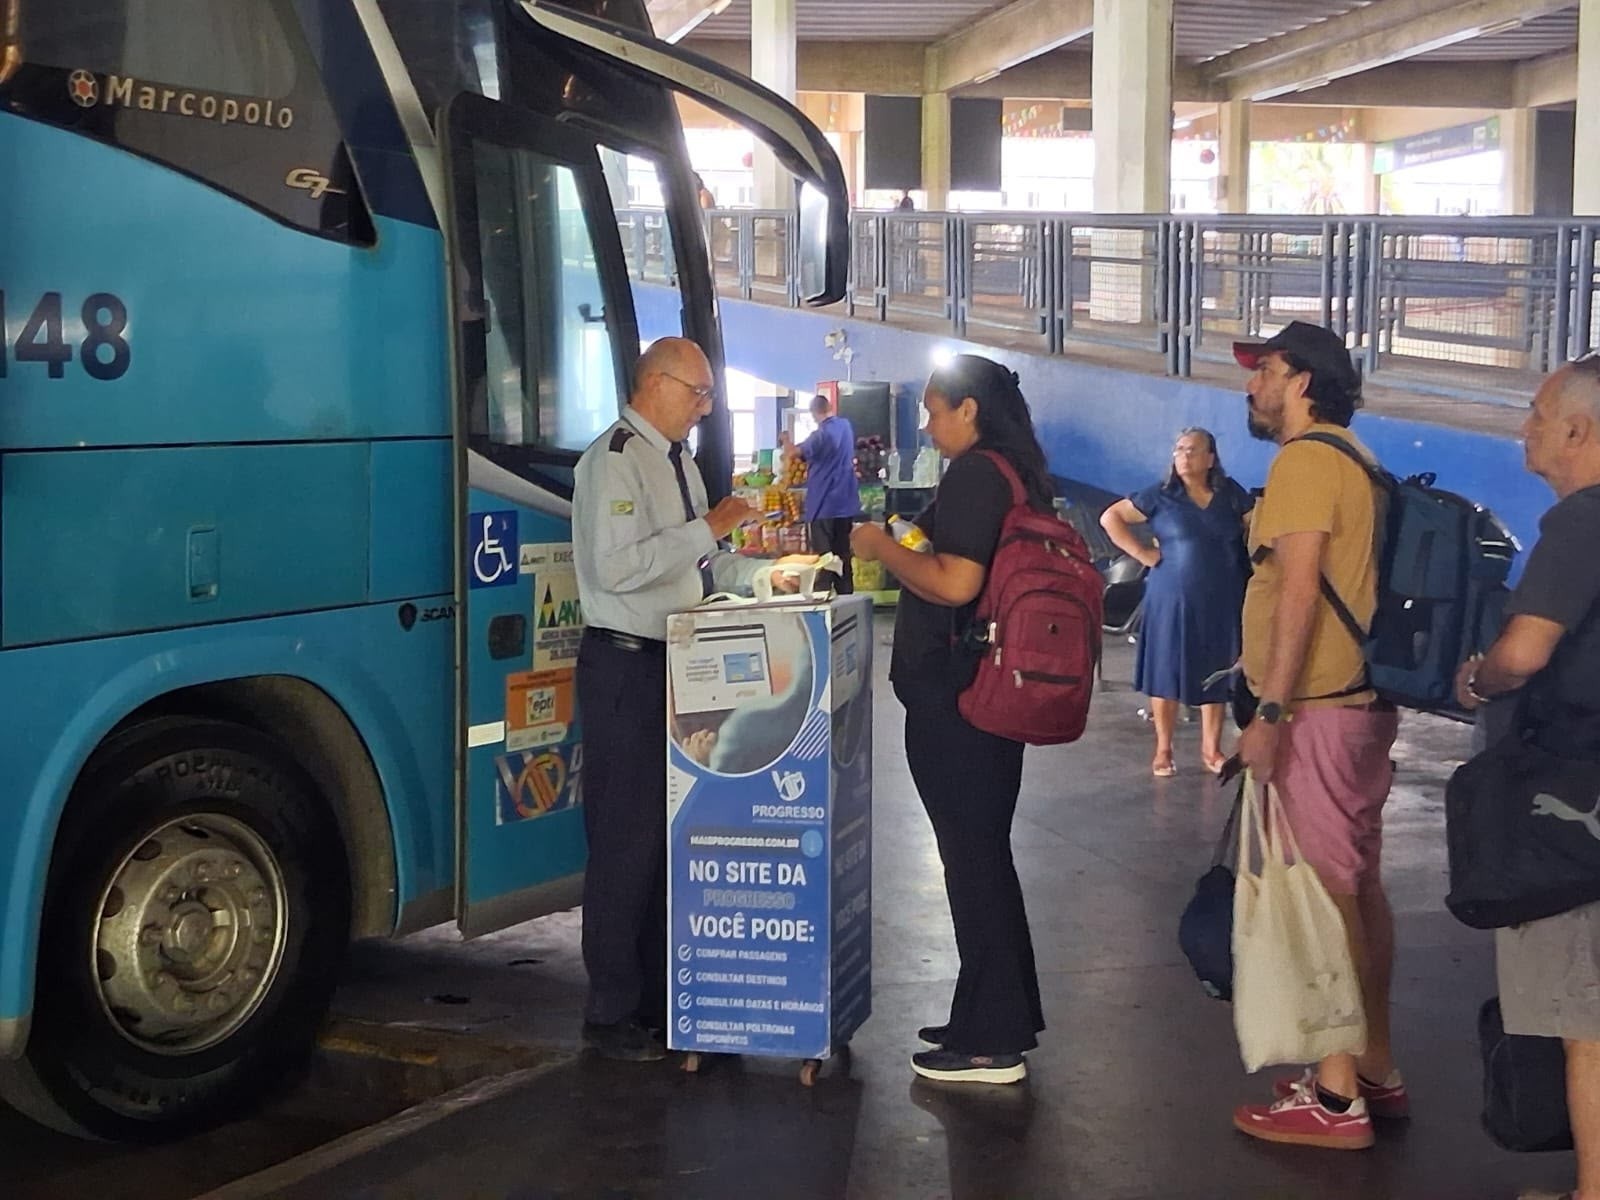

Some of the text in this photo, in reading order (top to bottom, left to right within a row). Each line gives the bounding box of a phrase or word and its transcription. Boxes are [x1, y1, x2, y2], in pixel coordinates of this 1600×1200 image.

[106, 75, 294, 129] Marcopolo
[286, 167, 347, 199] G7
[752, 805, 825, 820] PROGRESSO
[689, 860, 807, 886] NO SITE DA
[703, 889, 795, 910] PROGRESSO
[689, 912, 815, 942] VOCÊ PODE:
[696, 949, 788, 962] COMPRAR PASSAGENS
[696, 973, 788, 986] CONSULTAR DESTINOS
[696, 997, 745, 1009] CONSULTAR
[746, 999, 772, 1010] DATAS
[696, 1021, 745, 1032] CONSULTAR
